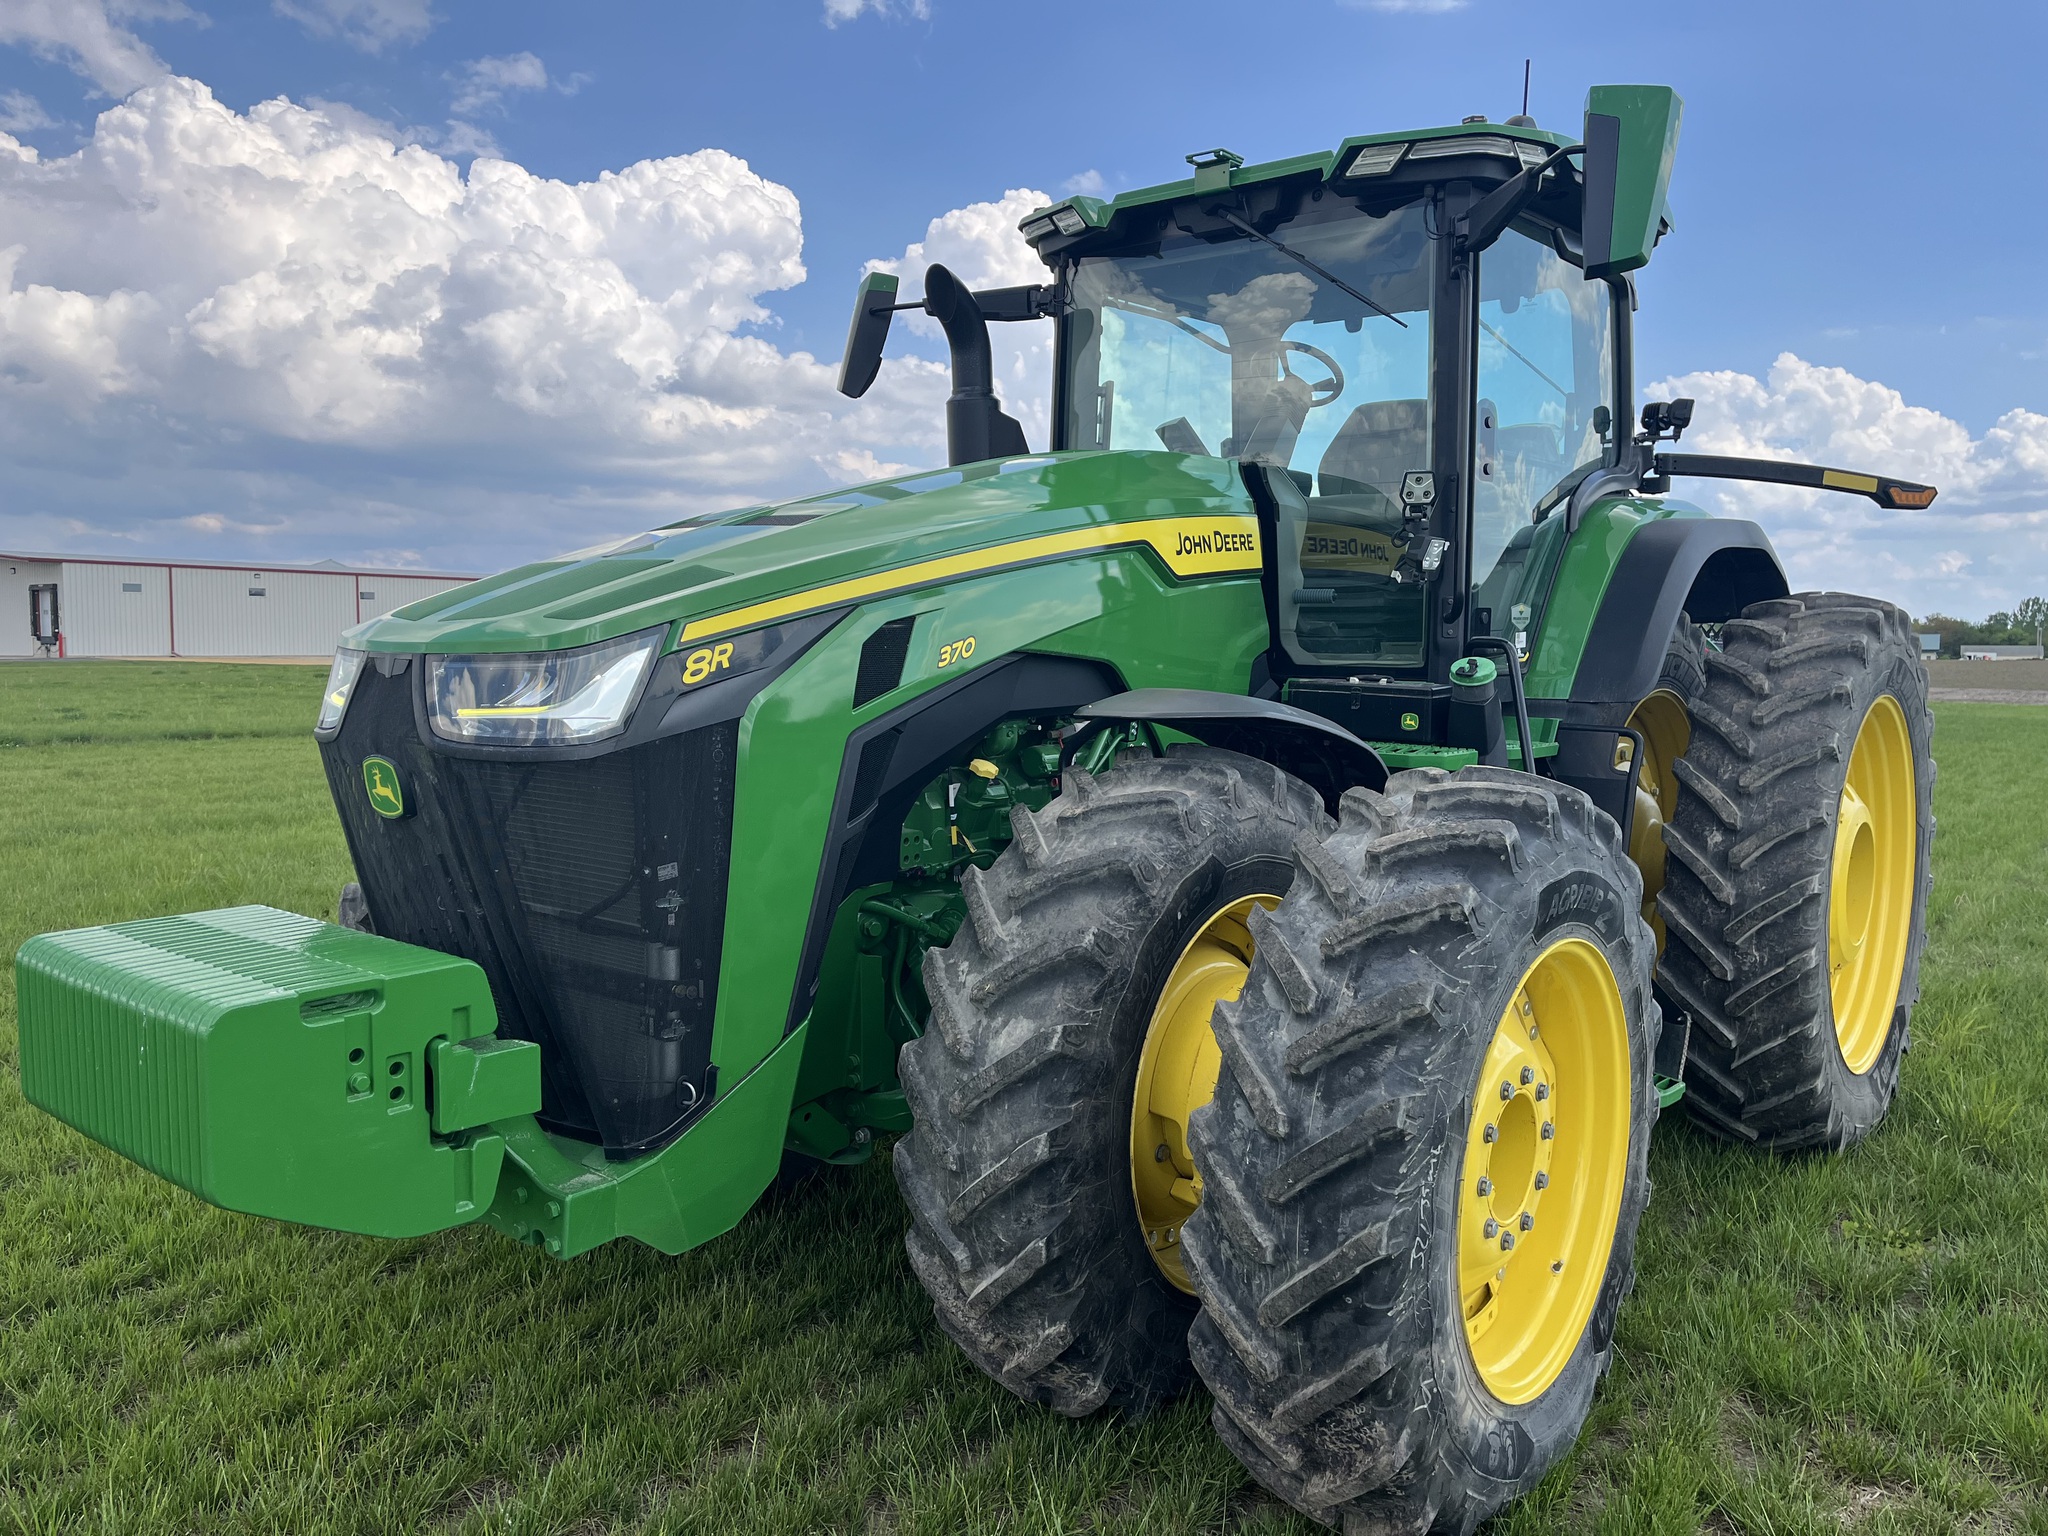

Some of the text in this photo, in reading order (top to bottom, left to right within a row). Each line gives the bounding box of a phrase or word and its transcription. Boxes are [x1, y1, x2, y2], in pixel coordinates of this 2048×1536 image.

[1176, 530, 1255, 556] JOHN DEERE
[682, 642, 735, 685] 8R
[937, 636, 976, 668] 370
